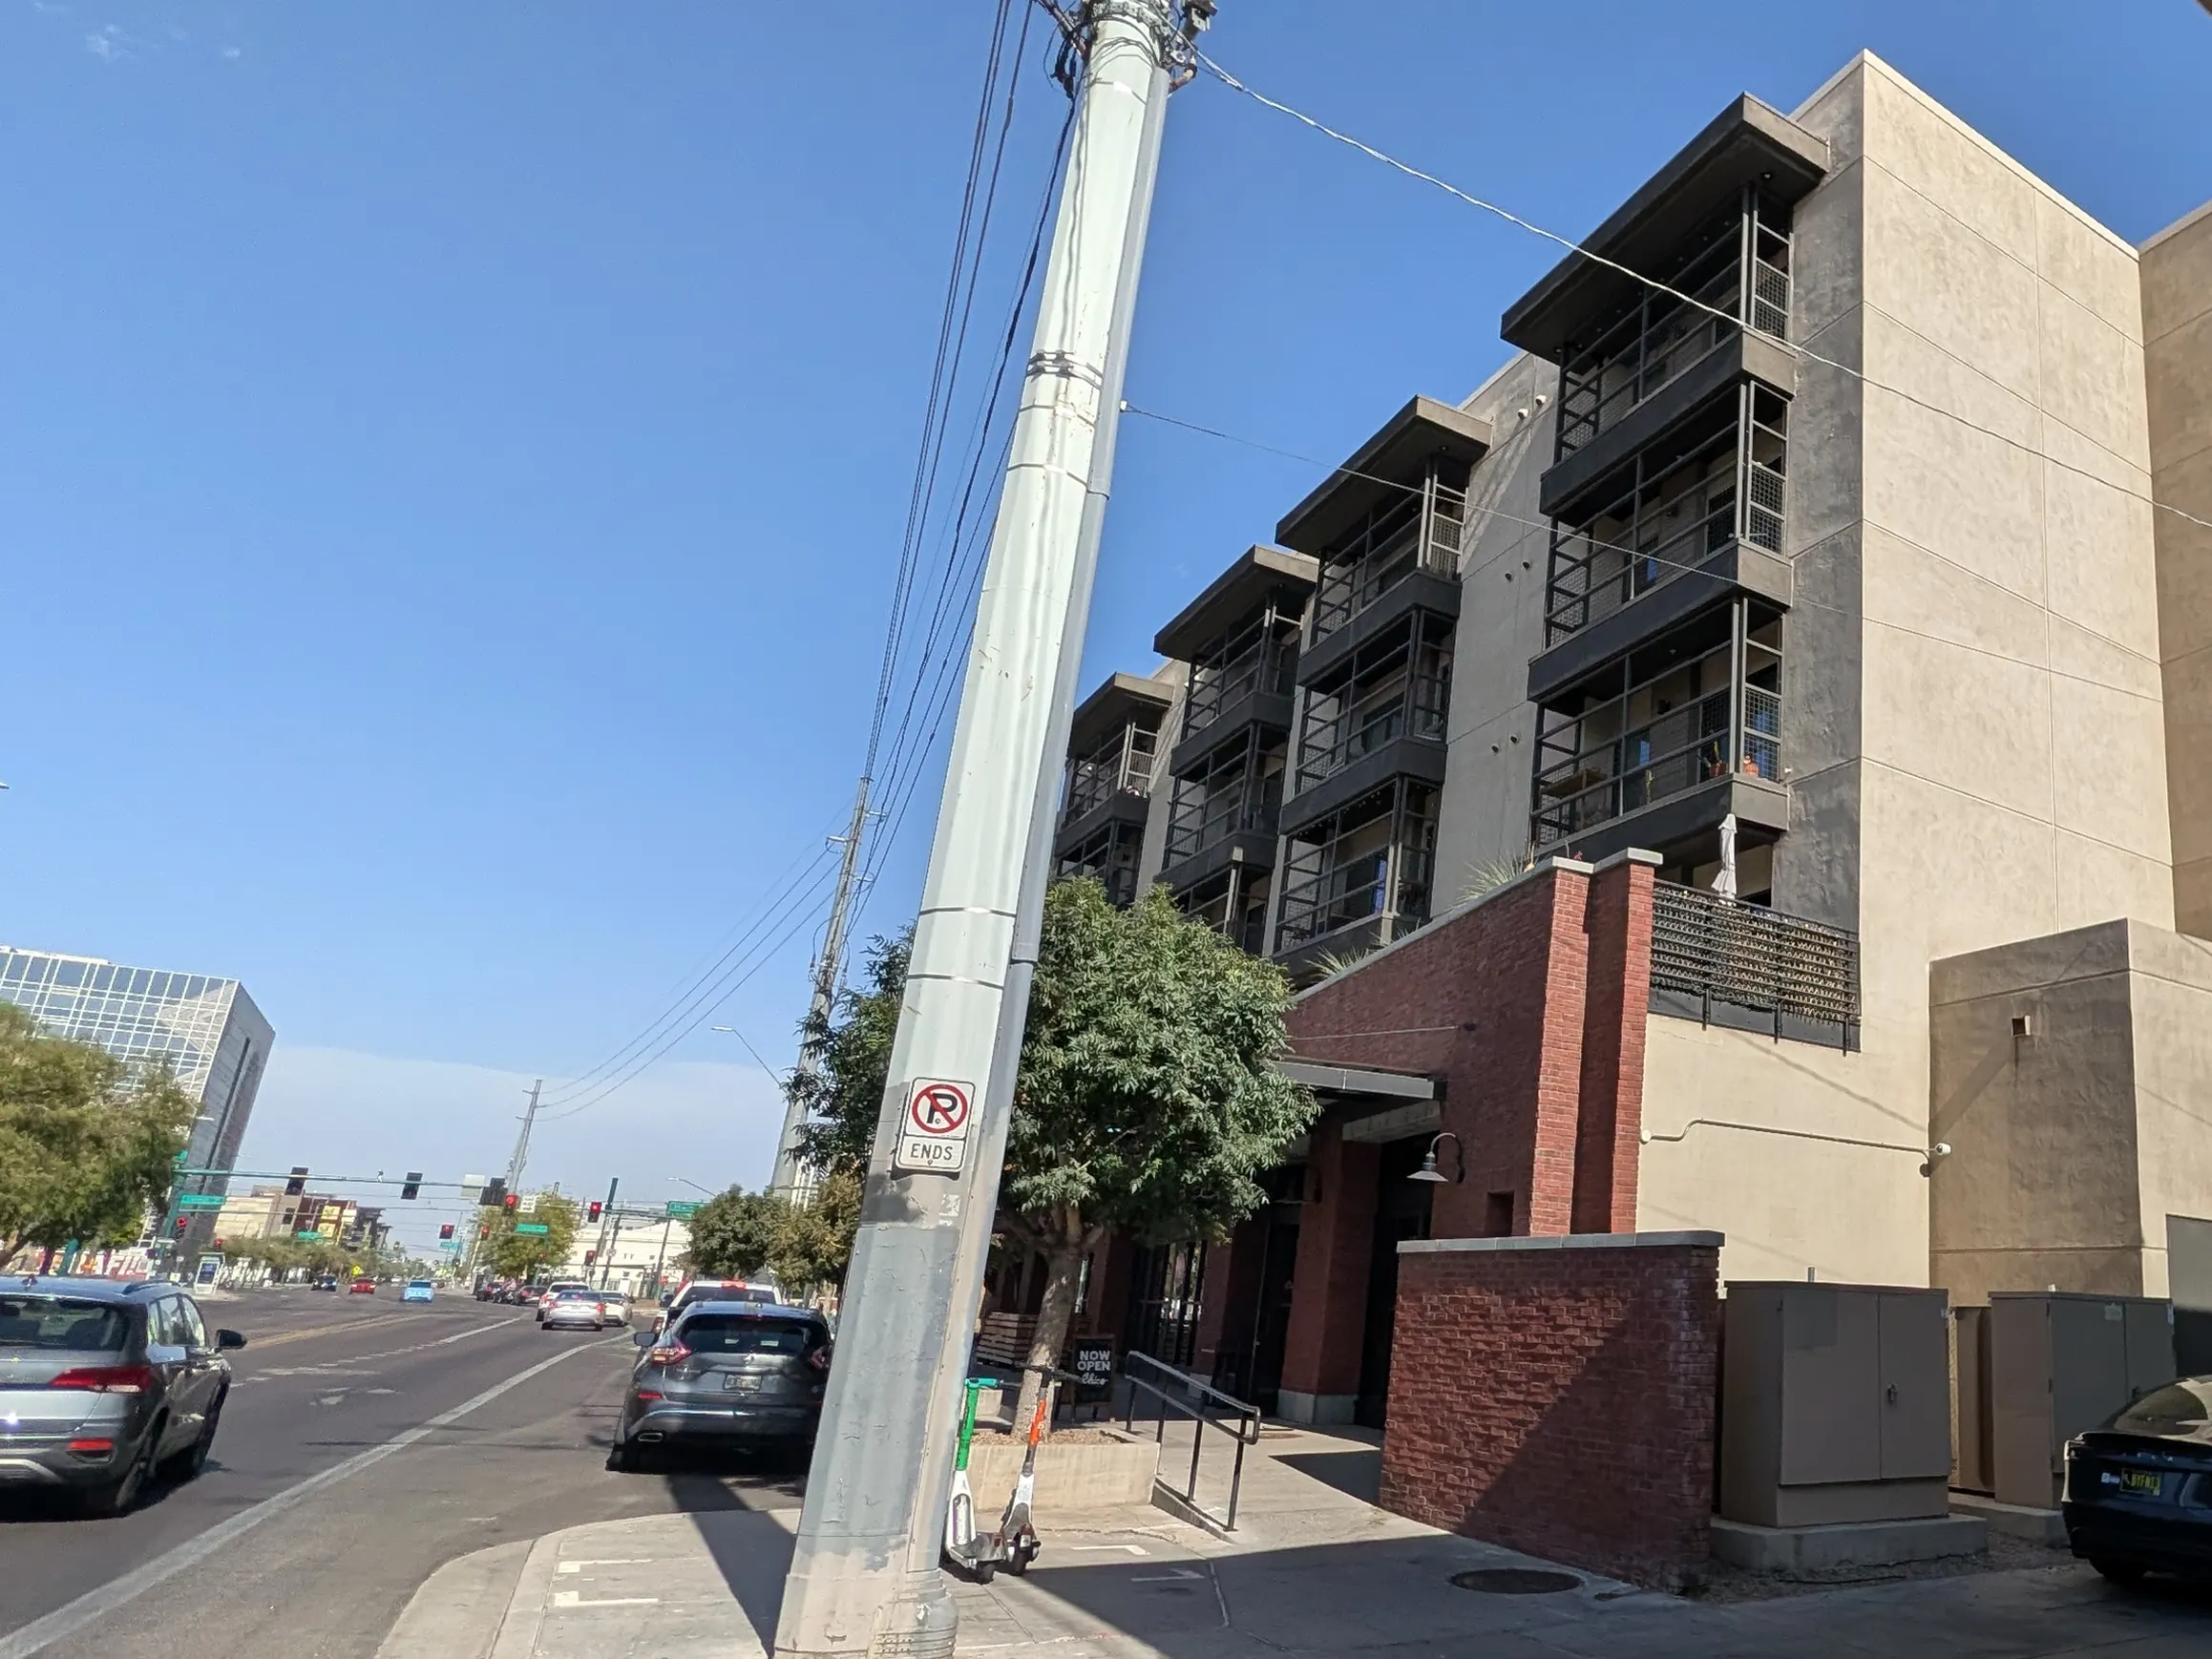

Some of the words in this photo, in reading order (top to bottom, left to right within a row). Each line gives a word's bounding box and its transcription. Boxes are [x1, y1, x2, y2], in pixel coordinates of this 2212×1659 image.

[910, 1143, 953, 1161] ENDS
[1079, 1350, 1110, 1360] NOW
[1077, 1360, 1110, 1371] OPEN
